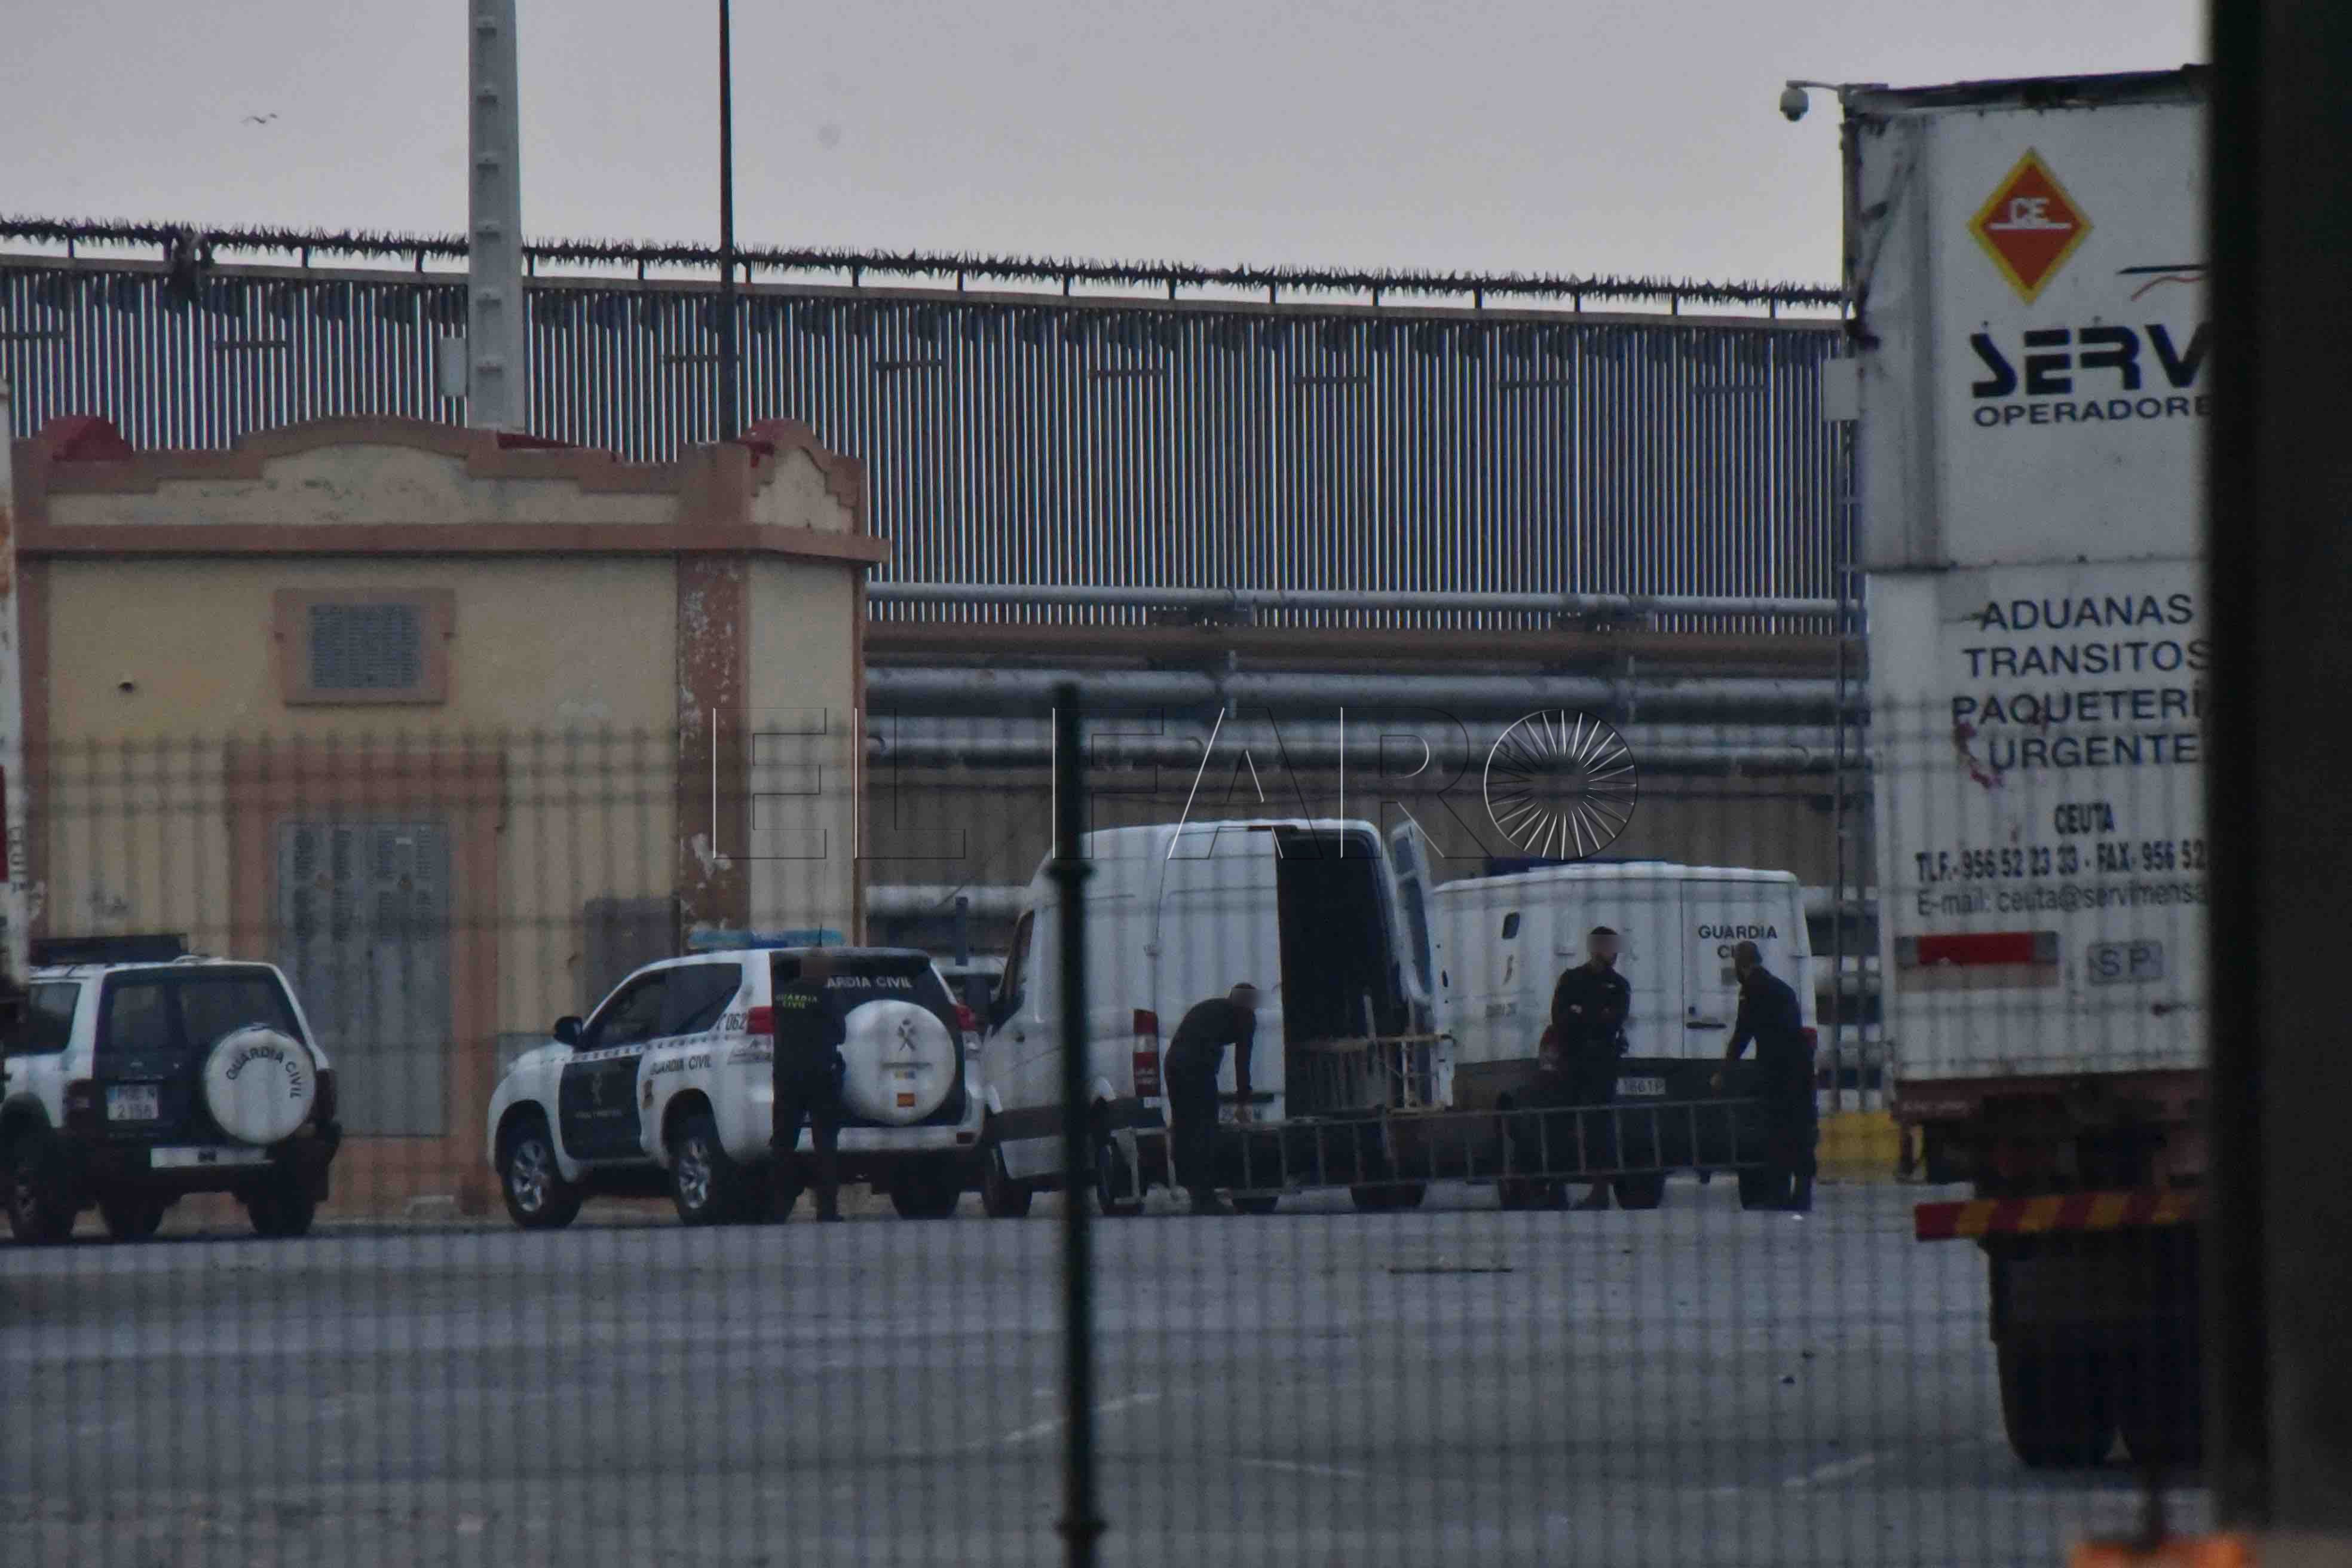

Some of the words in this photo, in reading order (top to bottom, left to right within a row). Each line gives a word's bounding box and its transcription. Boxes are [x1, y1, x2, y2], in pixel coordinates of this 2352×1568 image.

[1980, 594, 2194, 630] ADUANAS
[1962, 639, 2213, 678] TRANSITOS
[1989, 734, 2201, 771] URGENTE
[2054, 801, 2116, 835] CEUTA
[2000, 847, 2023, 877] 52
[2142, 840, 2175, 872] 956
[1698, 924, 1778, 939] GUARDIA
[2099, 946, 2151, 976] SP
[826, 975, 871, 989] ARDIA
[875, 975, 913, 988] CIVIL
[225, 1046, 284, 1081] GUARDIA
[284, 1060, 302, 1099] CIVIL
[688, 1054, 712, 1070] CIVIL
